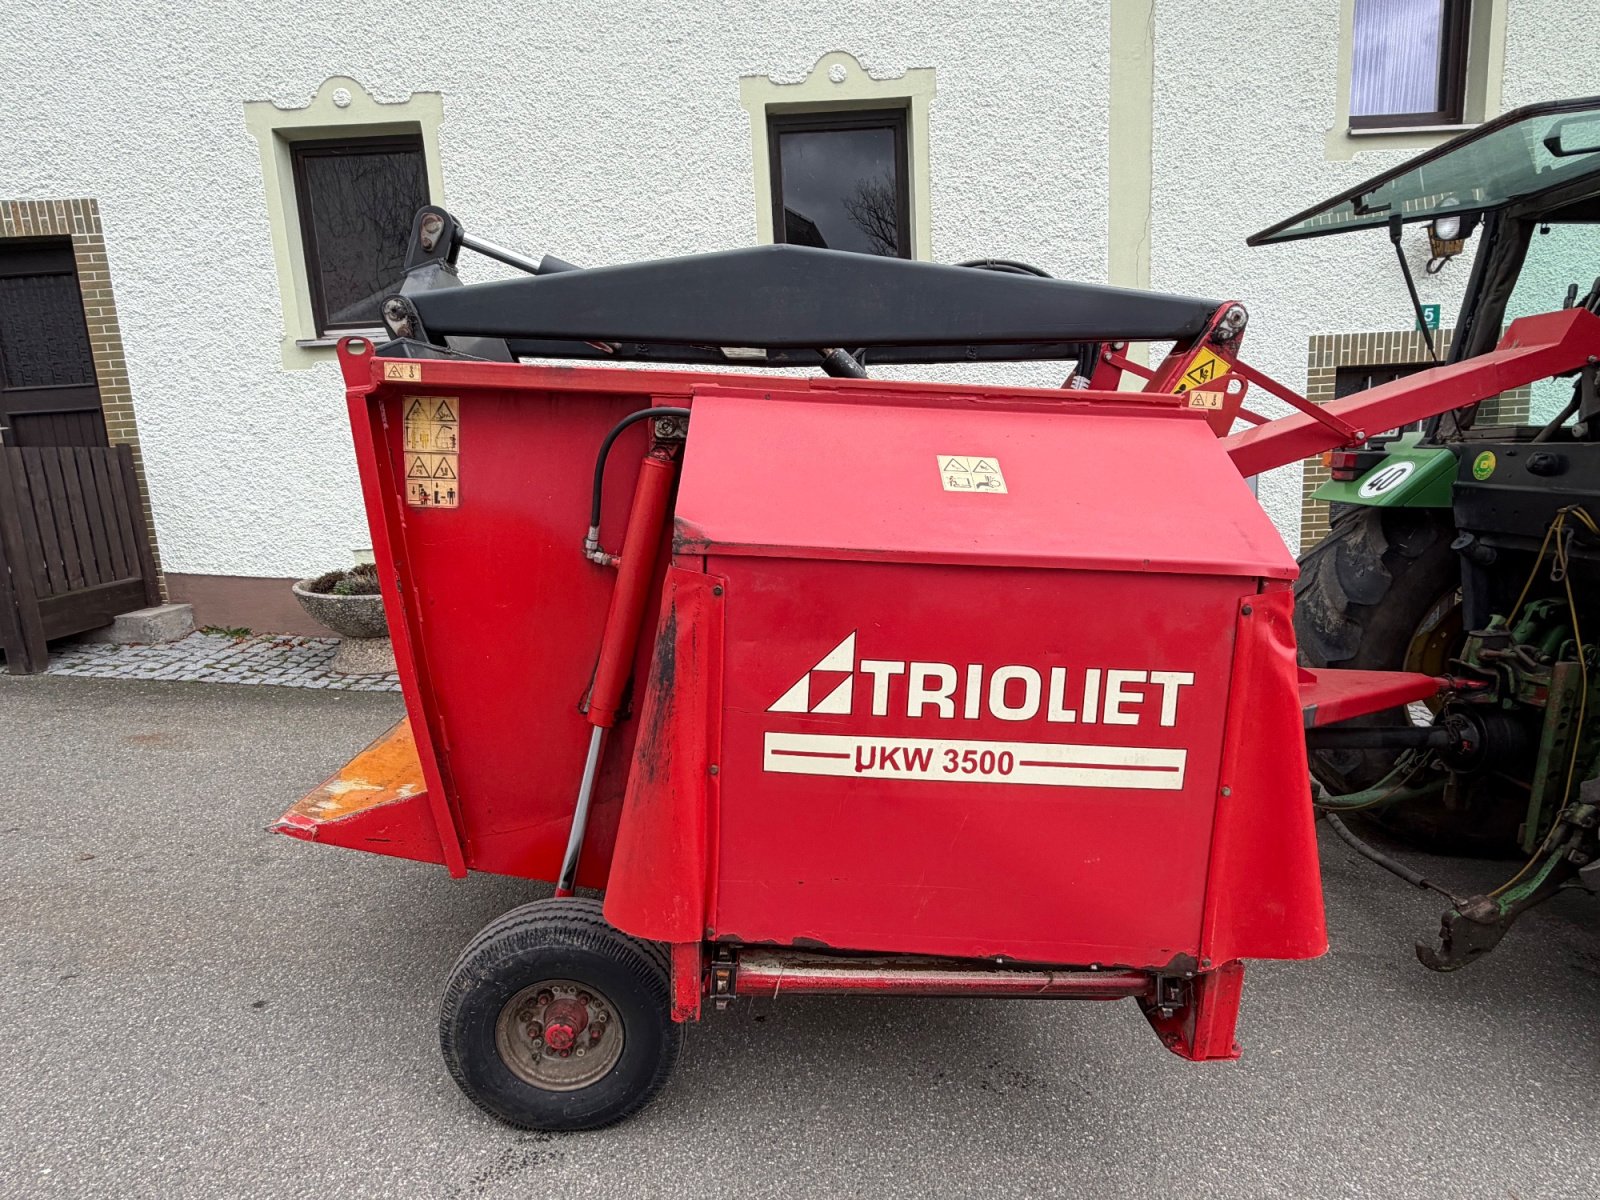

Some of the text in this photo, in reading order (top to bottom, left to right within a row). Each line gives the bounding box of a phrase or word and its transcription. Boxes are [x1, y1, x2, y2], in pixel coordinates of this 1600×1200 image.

[1424, 307, 1434, 322] 5
[1368, 467, 1407, 491] 40
[859, 659, 1195, 727] TRIOLIET
[942, 748, 1014, 775] 3500
